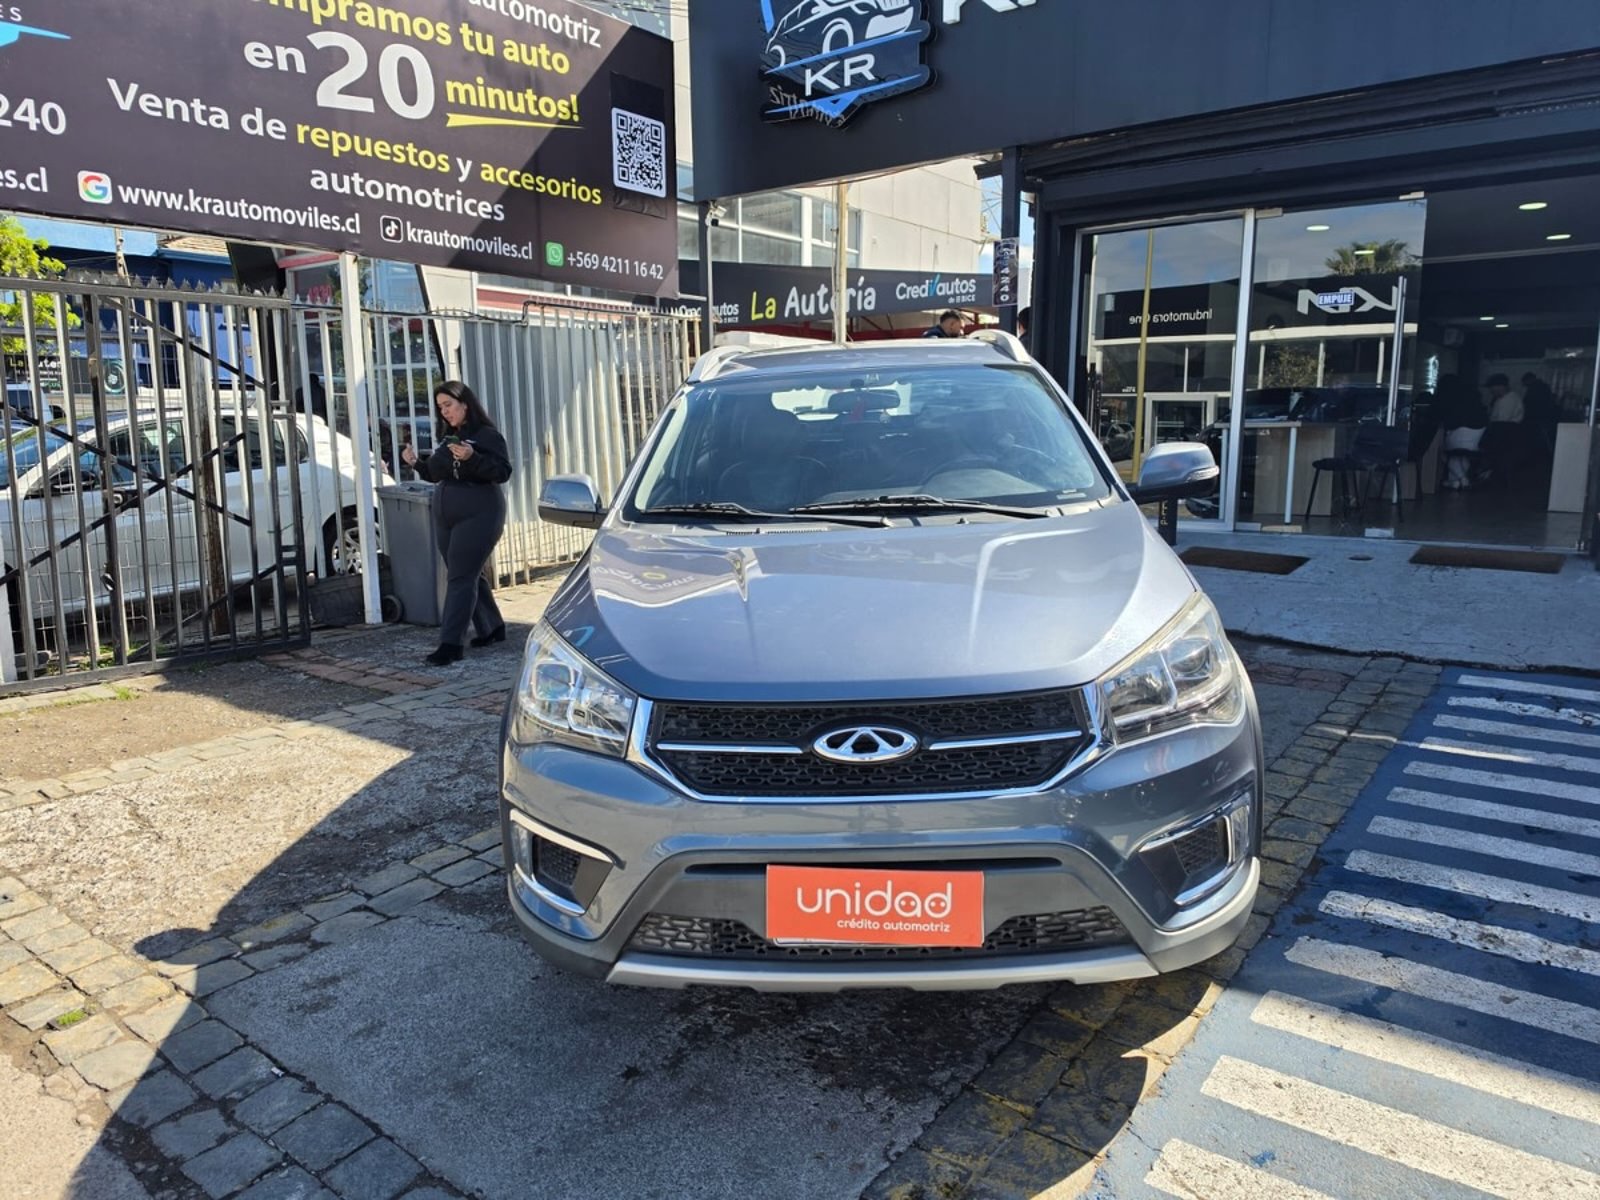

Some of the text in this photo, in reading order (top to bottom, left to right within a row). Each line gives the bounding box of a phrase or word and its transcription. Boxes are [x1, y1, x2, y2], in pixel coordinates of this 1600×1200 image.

[460, 22, 495, 56] tu
[502, 39, 570, 75] auto
[243, 31, 580, 122] en 20 minutos!
[805, 53, 877, 96] KR
[107, 78, 603, 205] Venta de repuestos y accesorios
[118, 184, 361, 234] www.krautomoviles.cl
[310, 168, 506, 222] automotrices
[406, 221, 533, 260] krautomoviles.cl
[567, 250, 664, 280] +569 4211 16 42
[751, 290, 776, 320] La
[1319, 293, 1354, 306] EMPUJE
[796, 880, 953, 918] unidad
[837, 917, 951, 933] crédito automotriz
